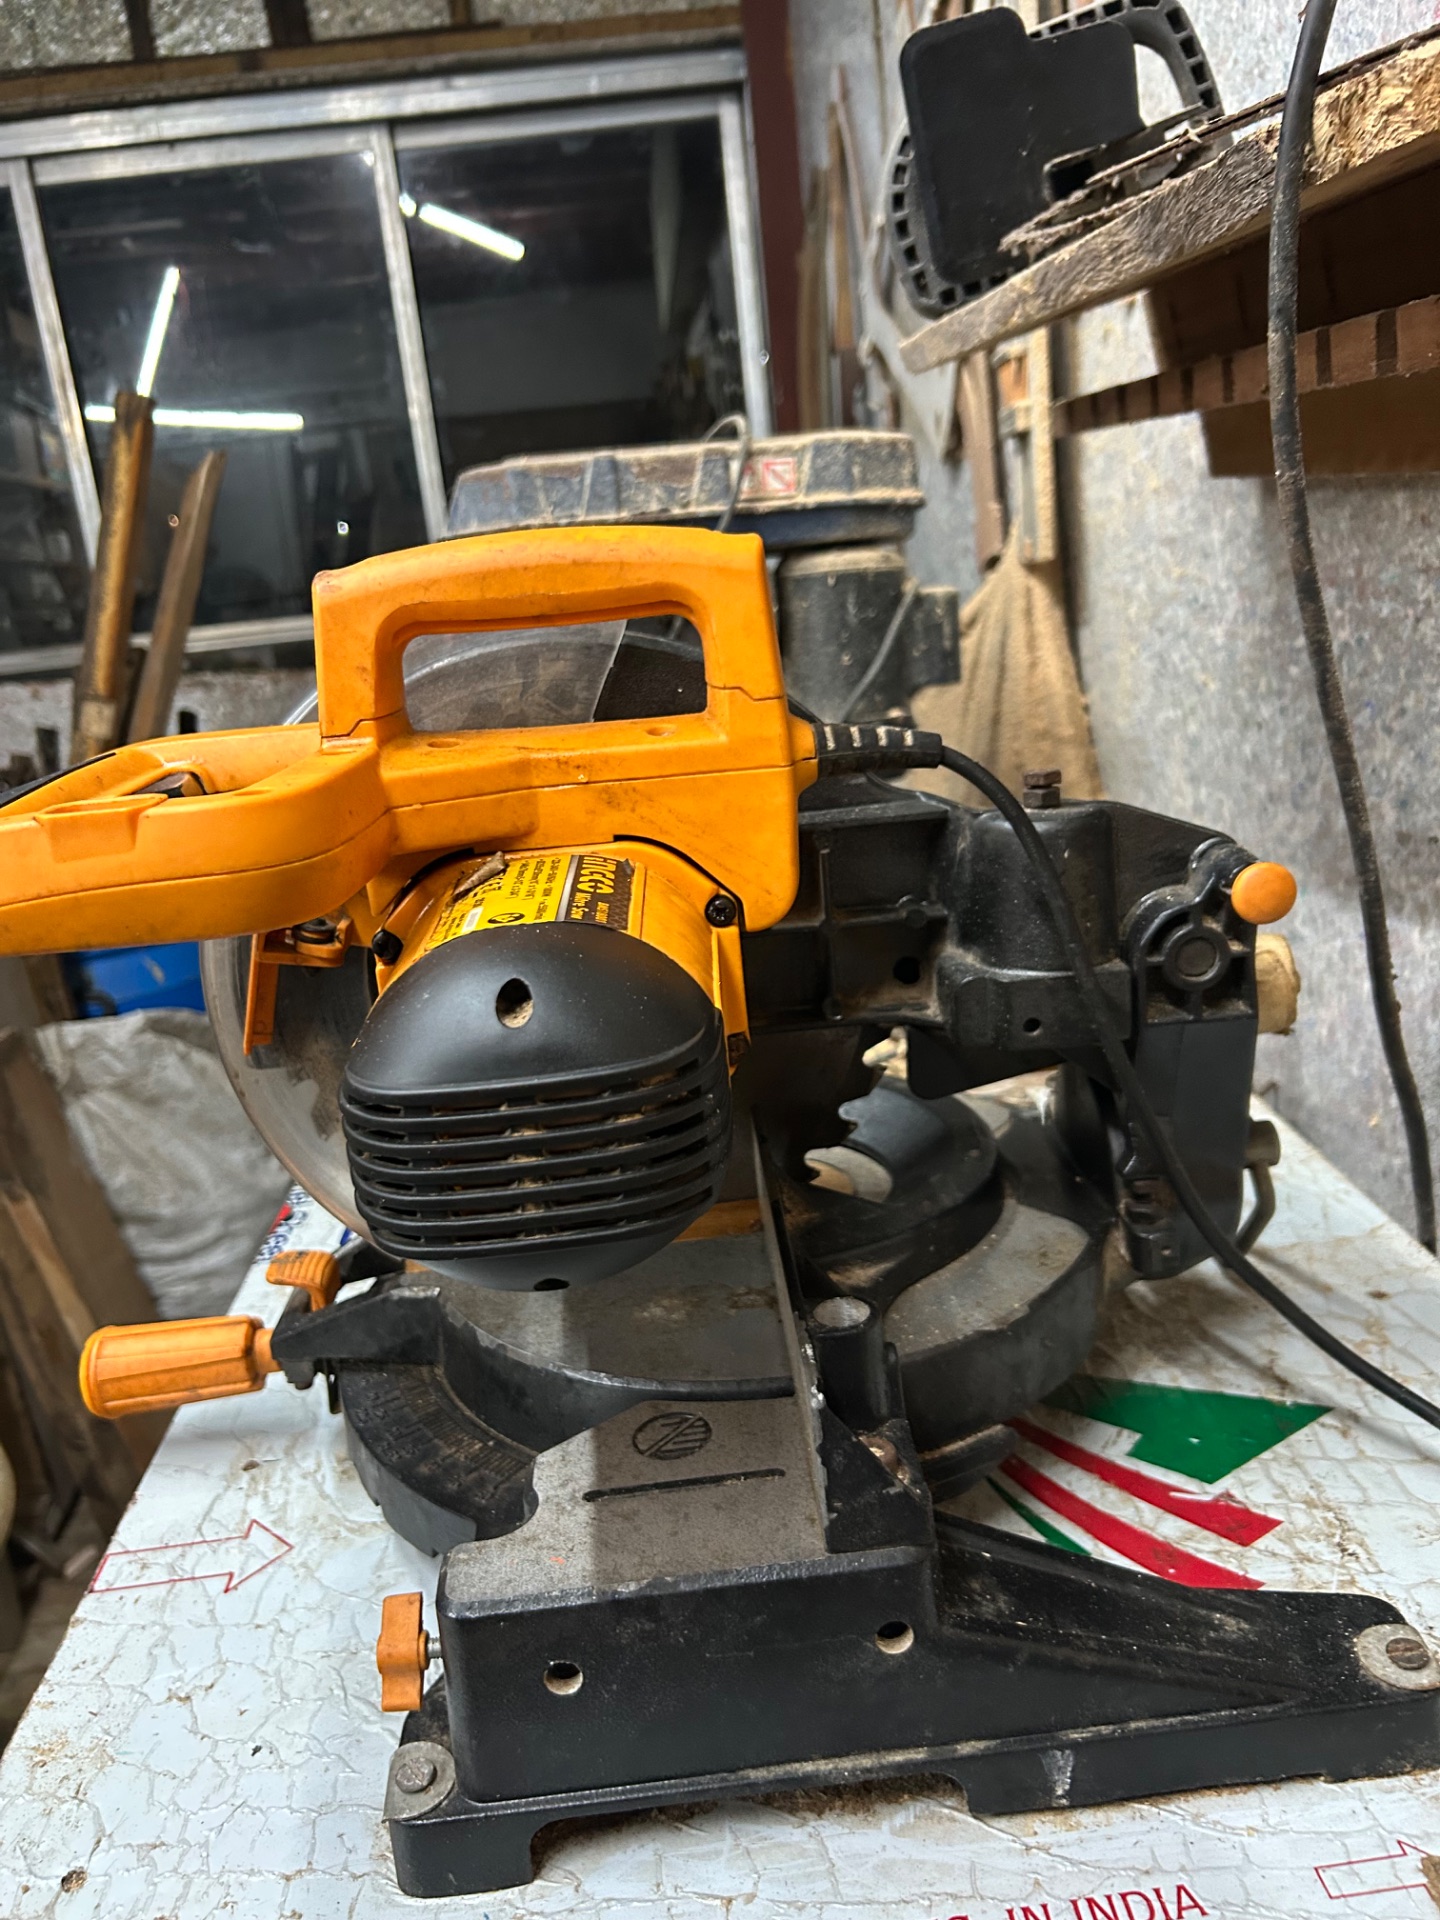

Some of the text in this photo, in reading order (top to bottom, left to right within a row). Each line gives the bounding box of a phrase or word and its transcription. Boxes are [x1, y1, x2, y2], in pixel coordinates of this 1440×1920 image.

[570, 892, 592, 920] Mitre Saw
[1069, 1883, 1210, 1920] INDIA
